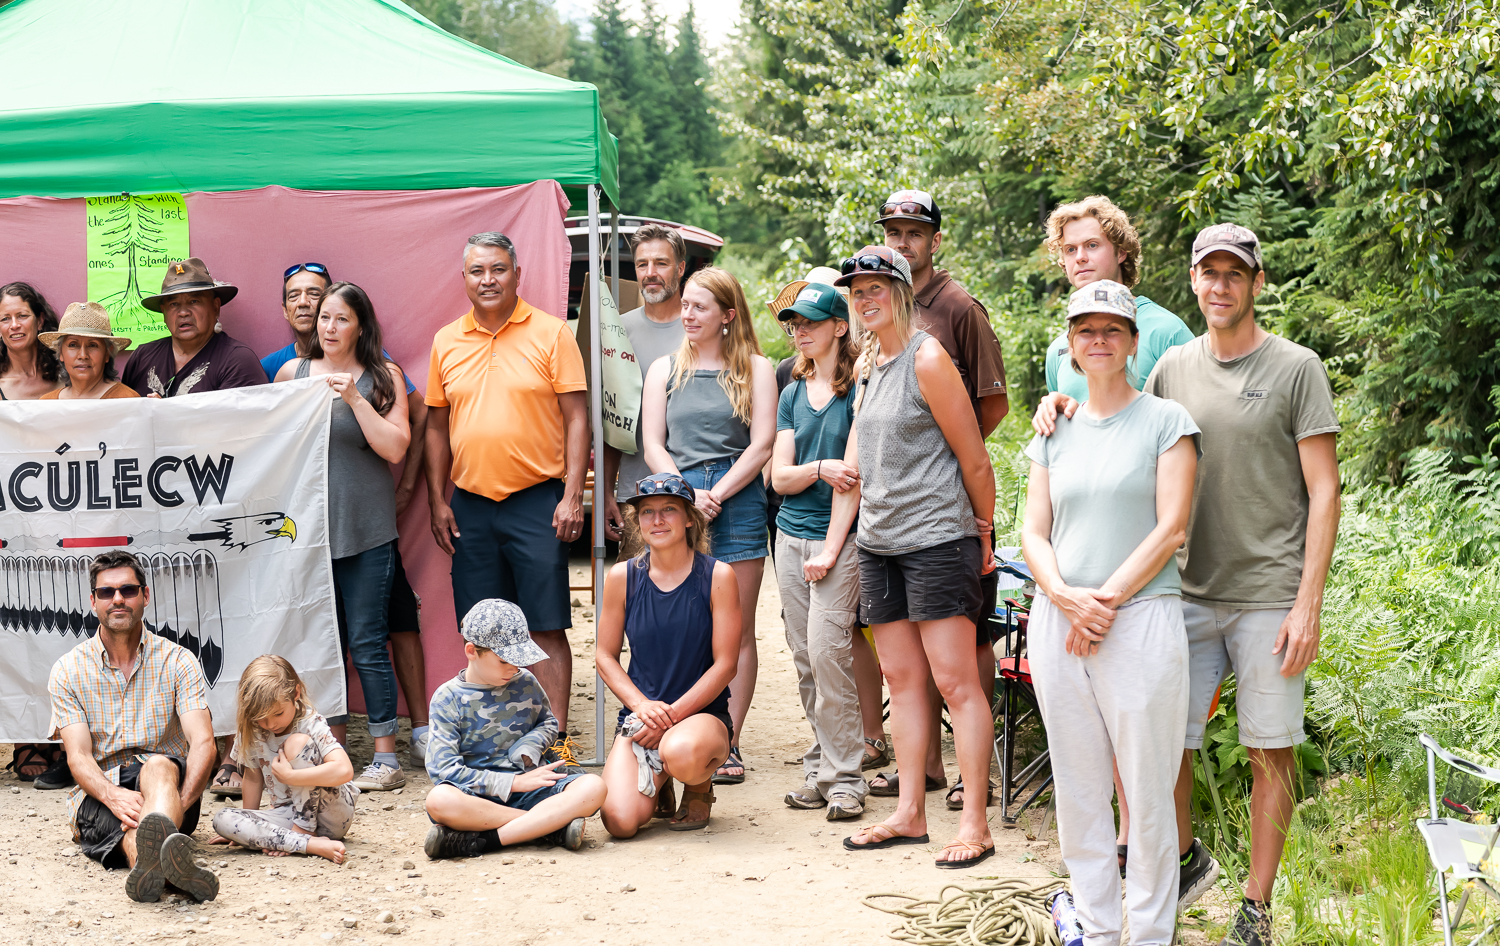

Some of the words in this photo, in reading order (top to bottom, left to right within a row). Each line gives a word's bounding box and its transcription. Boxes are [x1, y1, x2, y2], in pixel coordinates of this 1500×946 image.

[87, 215, 105, 228] the
[160, 206, 185, 221] last
[88, 259, 115, 269] ones
[604, 390, 617, 409] ON
